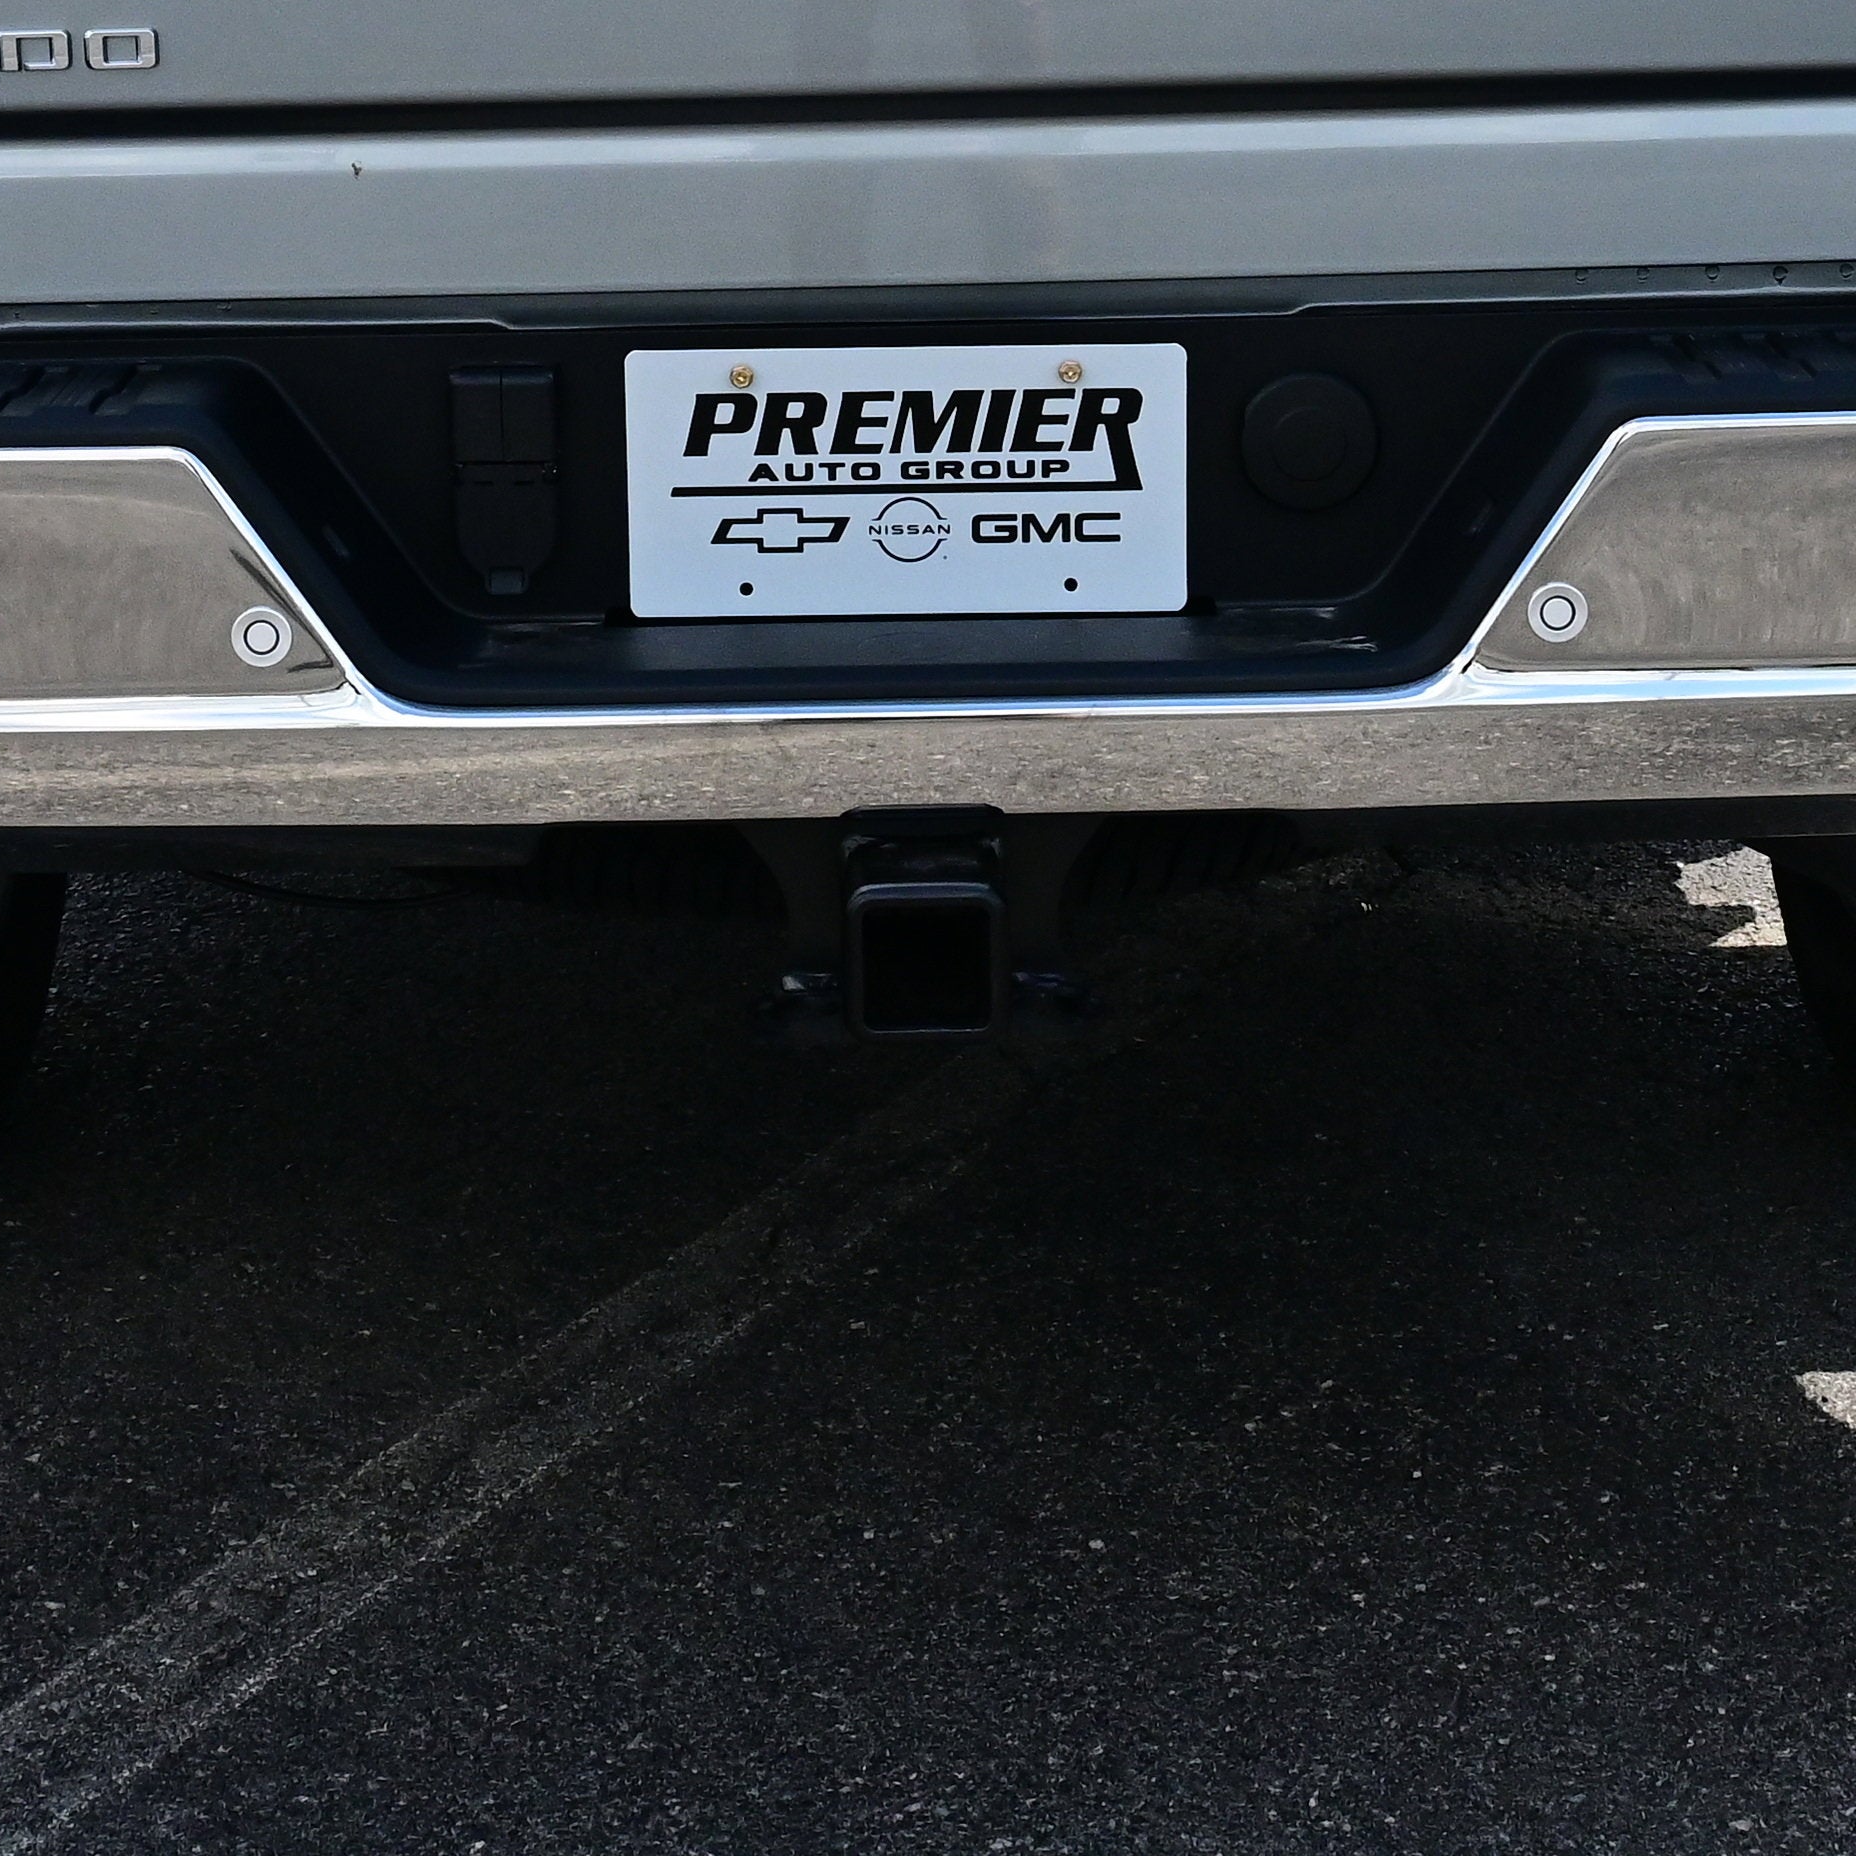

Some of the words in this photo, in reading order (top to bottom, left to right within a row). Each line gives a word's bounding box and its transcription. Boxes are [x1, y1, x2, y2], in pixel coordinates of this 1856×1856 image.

[682, 387, 1144, 491] PREMIER
[747, 462, 881, 483] AUTO
[899, 459, 1071, 481] GROUP
[867, 521, 952, 538] NISSAN
[970, 511, 1122, 544] GMC
